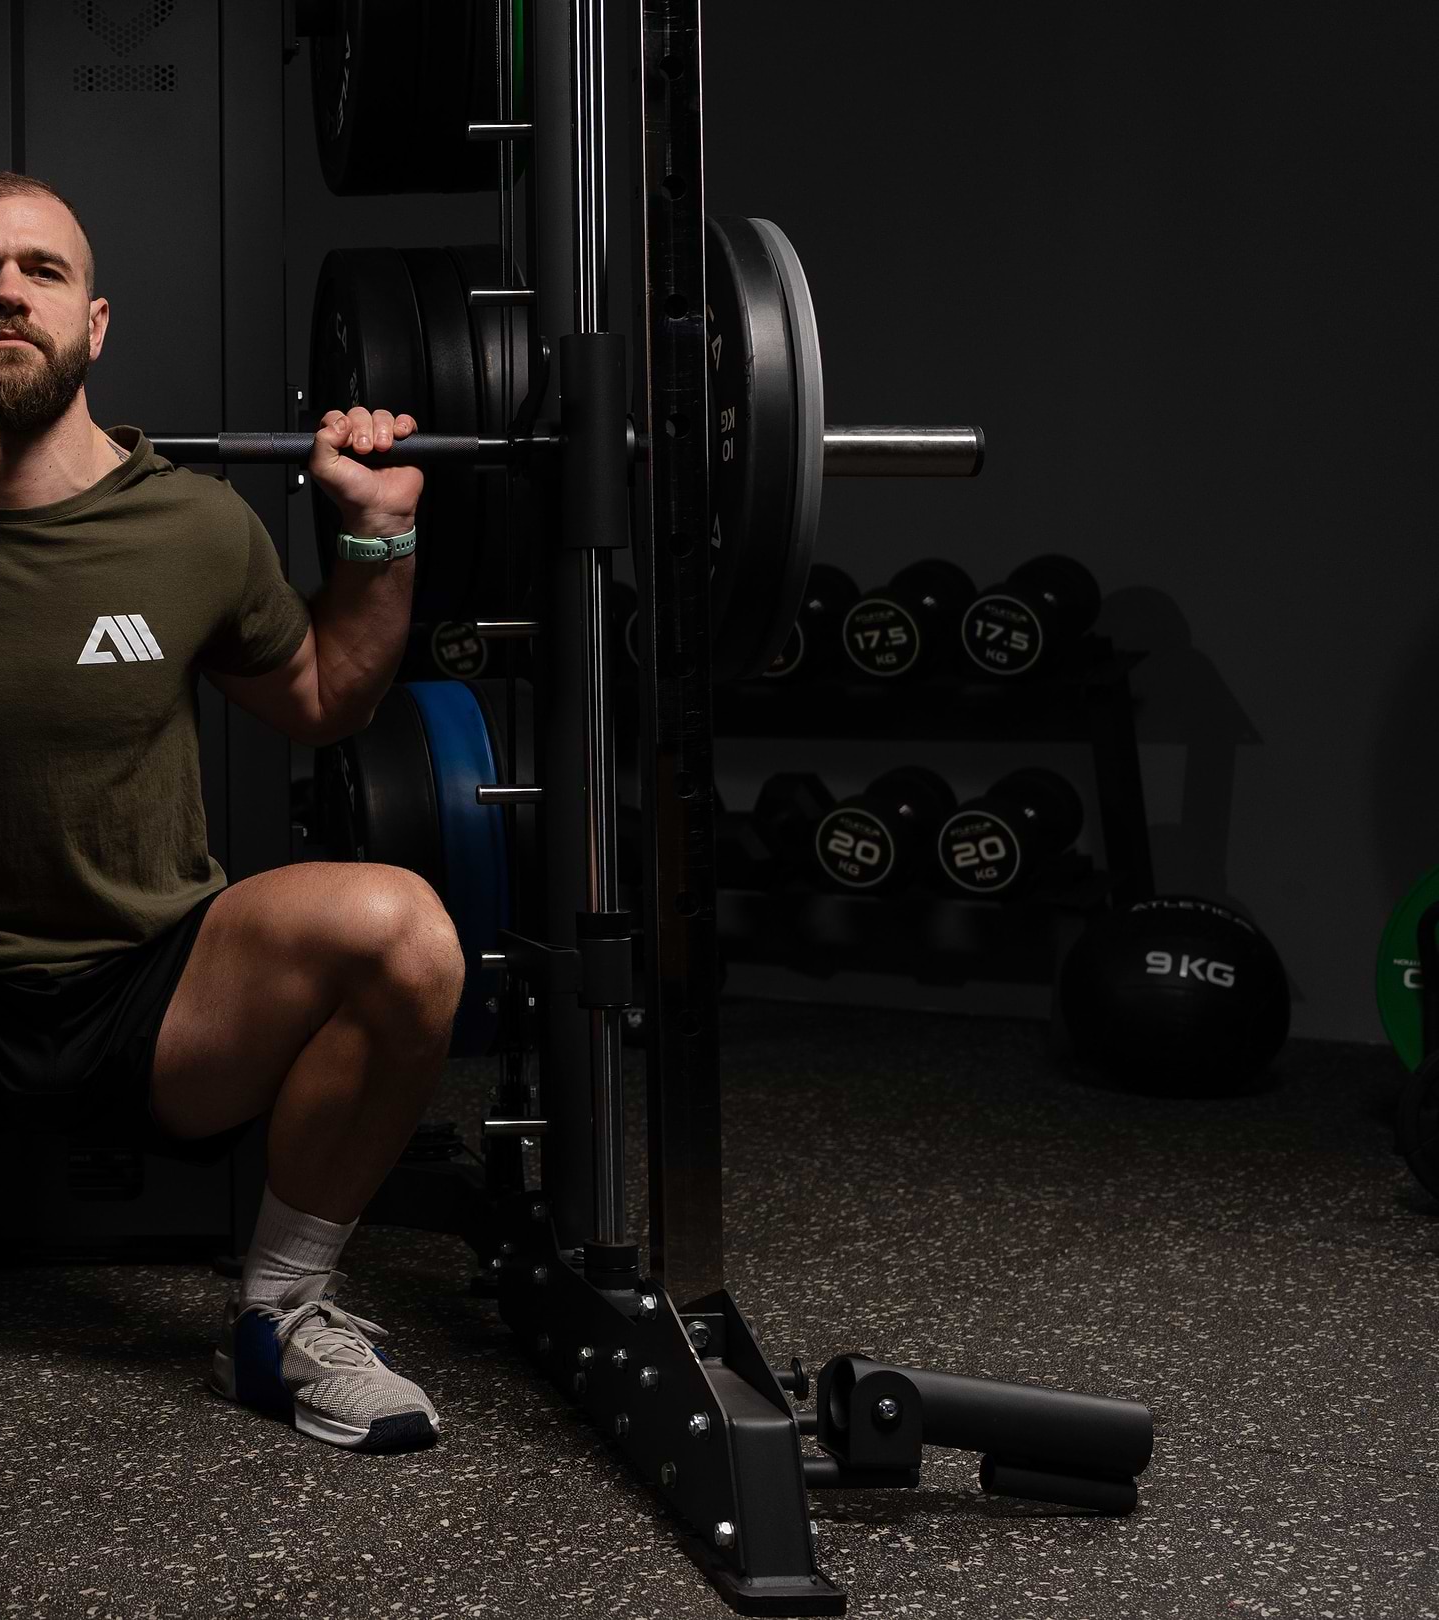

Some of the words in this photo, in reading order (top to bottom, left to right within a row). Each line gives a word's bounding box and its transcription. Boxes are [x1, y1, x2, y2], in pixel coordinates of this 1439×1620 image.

[720, 406, 735, 433] KG
[722, 437, 734, 462] 10
[853, 626, 908, 651] 17.5
[975, 619, 1030, 652] 17.5
[875, 652, 898, 666] KG
[985, 647, 1008, 664] KG
[827, 829, 880, 866] 20
[951, 835, 1006, 869] 20
[838, 859, 861, 877] KG
[974, 866, 998, 881] KG
[1145, 950, 1173, 975] 9
[1179, 953, 1236, 988] KG
